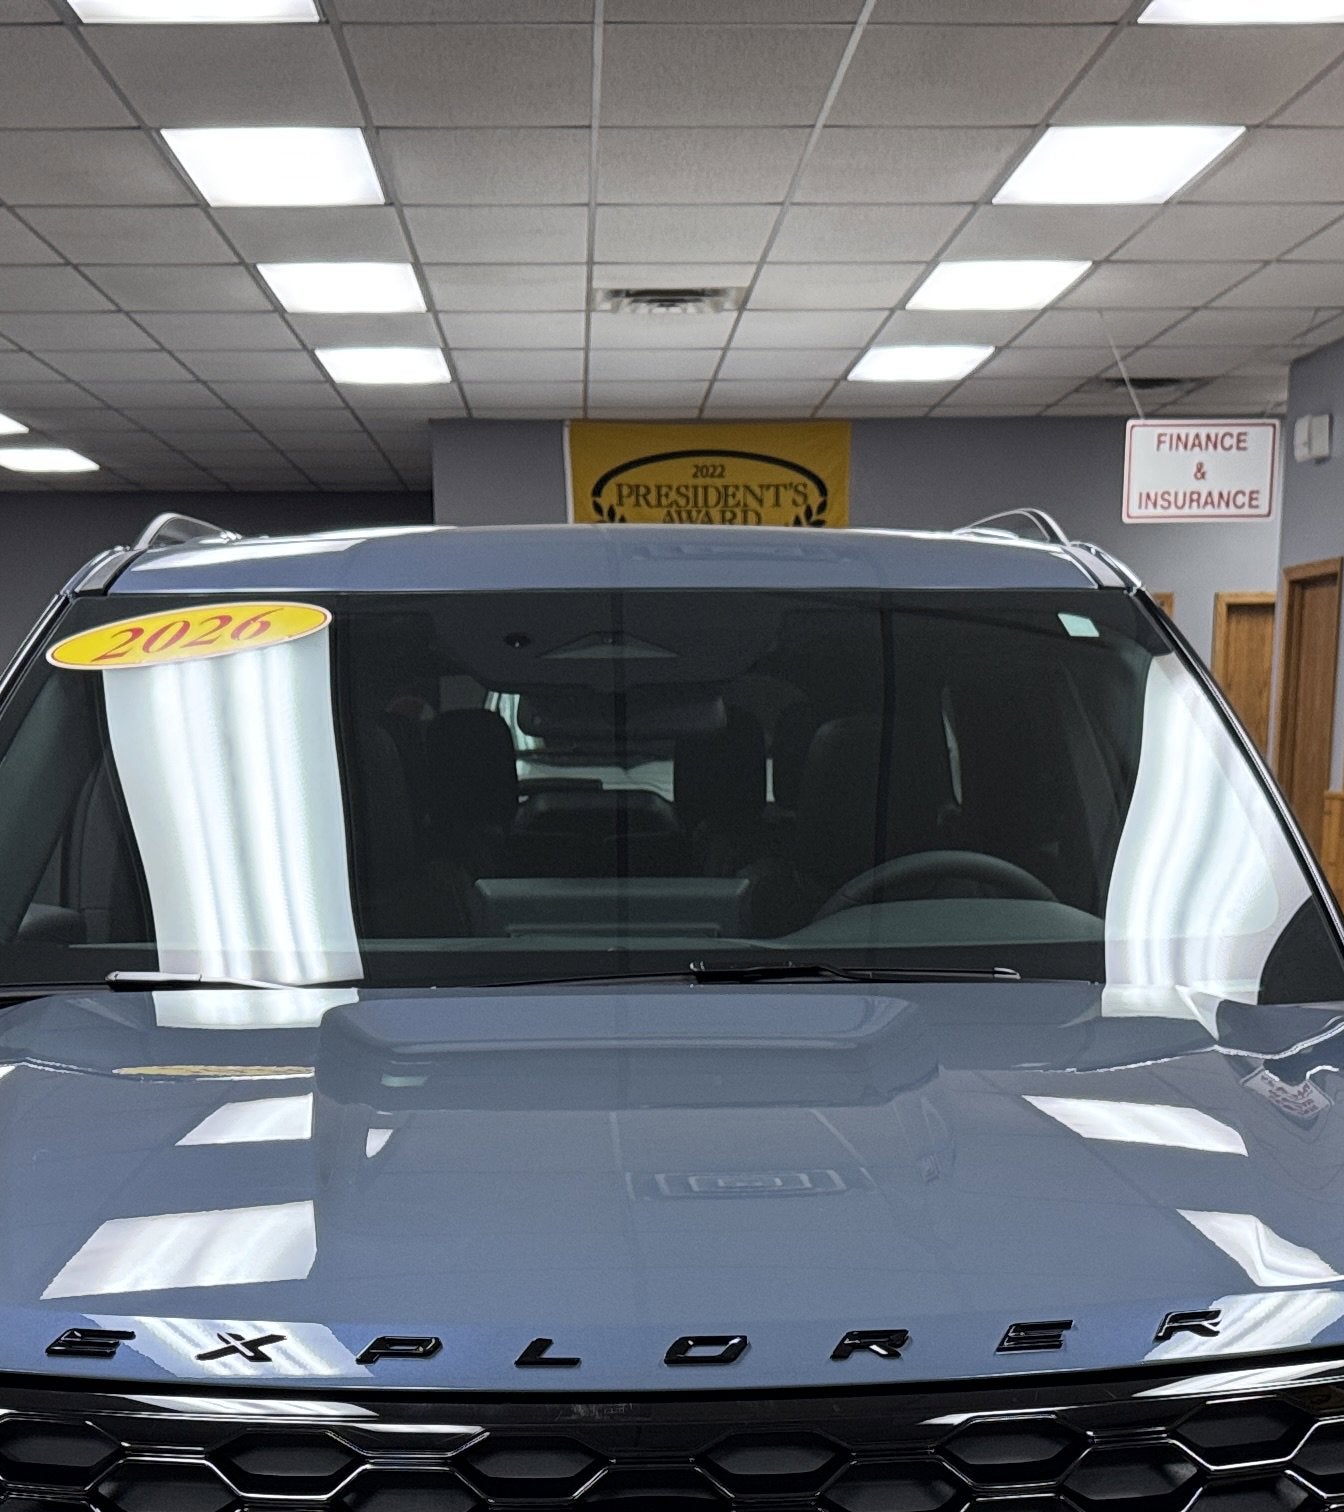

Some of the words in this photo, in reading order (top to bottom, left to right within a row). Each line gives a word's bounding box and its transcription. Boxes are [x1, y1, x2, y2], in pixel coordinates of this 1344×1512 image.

[1156, 431, 1248, 452] FINANCE
[691, 464, 726, 479] 2022
[1193, 462, 1206, 481] &
[615, 482, 809, 508] PRESIDENT'S
[1137, 490, 1260, 510] INSURANCE
[91, 607, 285, 663] 2026
[44, 1308, 1227, 1370] EXPLORER
